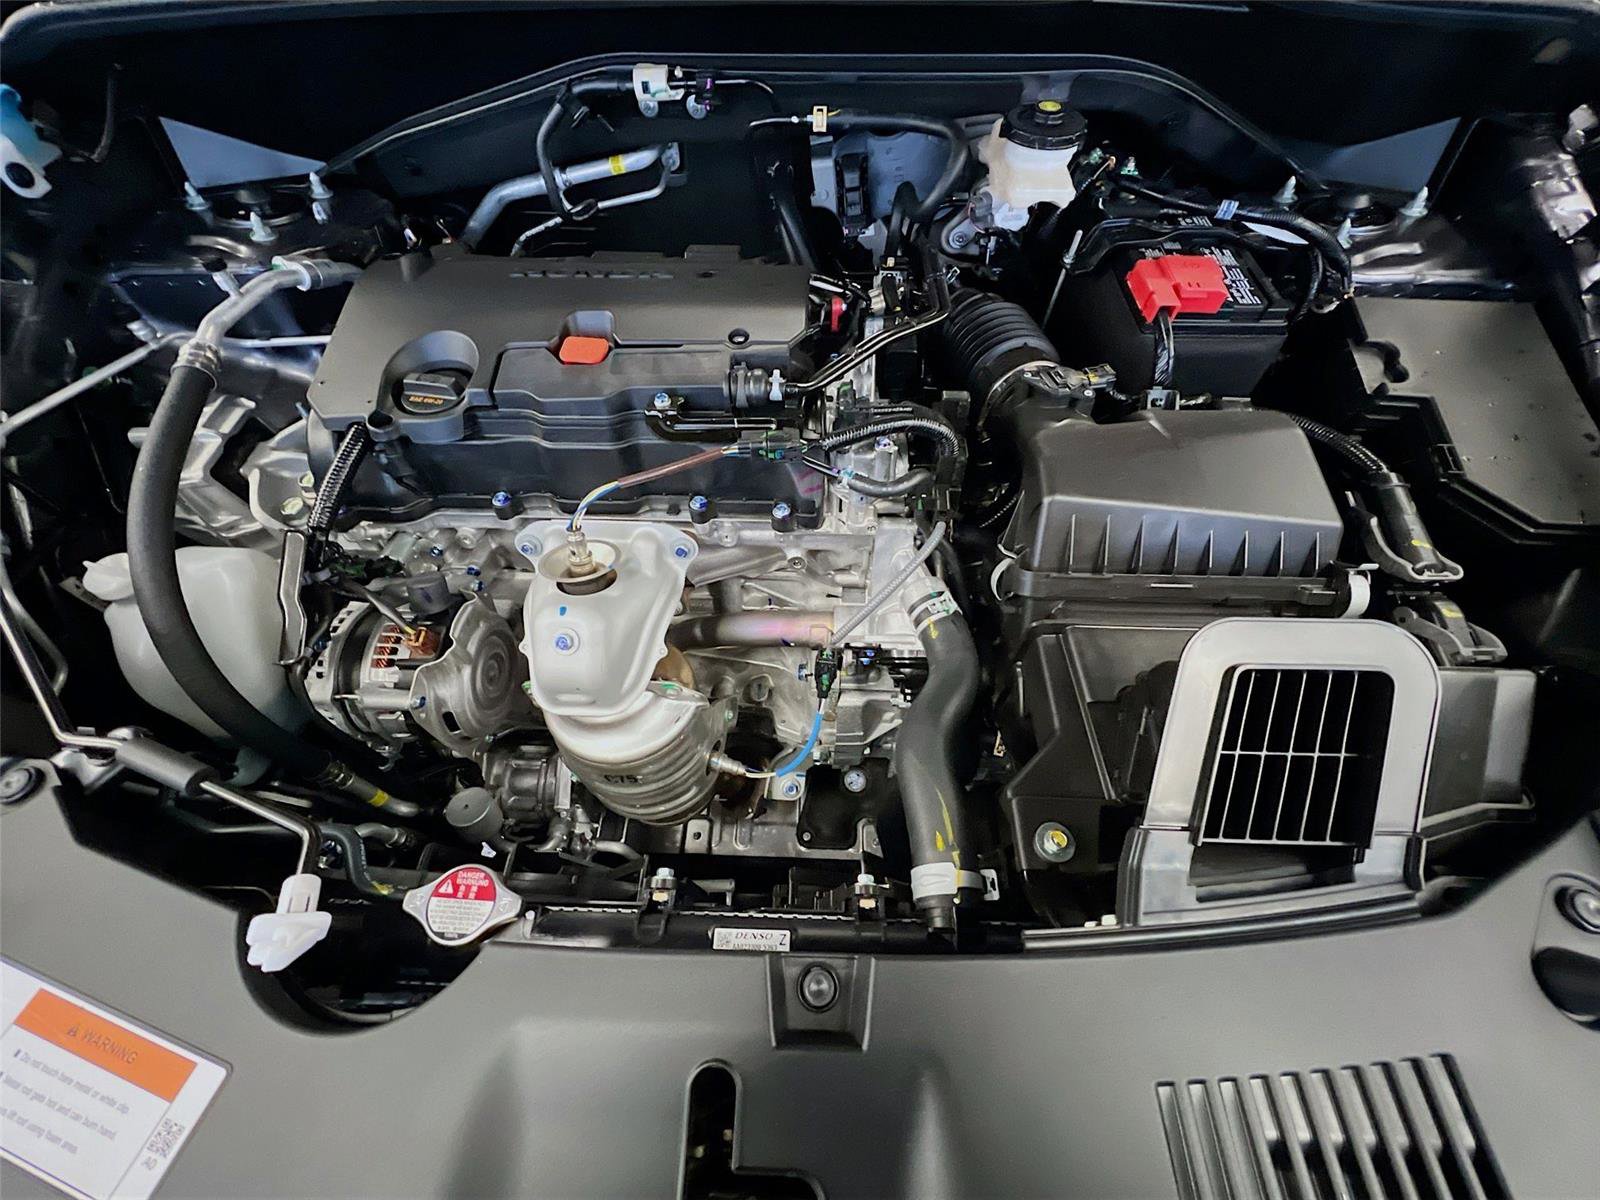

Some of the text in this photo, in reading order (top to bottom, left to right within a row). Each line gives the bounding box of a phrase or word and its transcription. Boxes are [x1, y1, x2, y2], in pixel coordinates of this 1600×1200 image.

[457, 871, 486, 879] DANGER
[456, 878, 490, 887] WARNING
[735, 931, 787, 946] DENSO Z
[82, 1028, 138, 1064] WARNING
